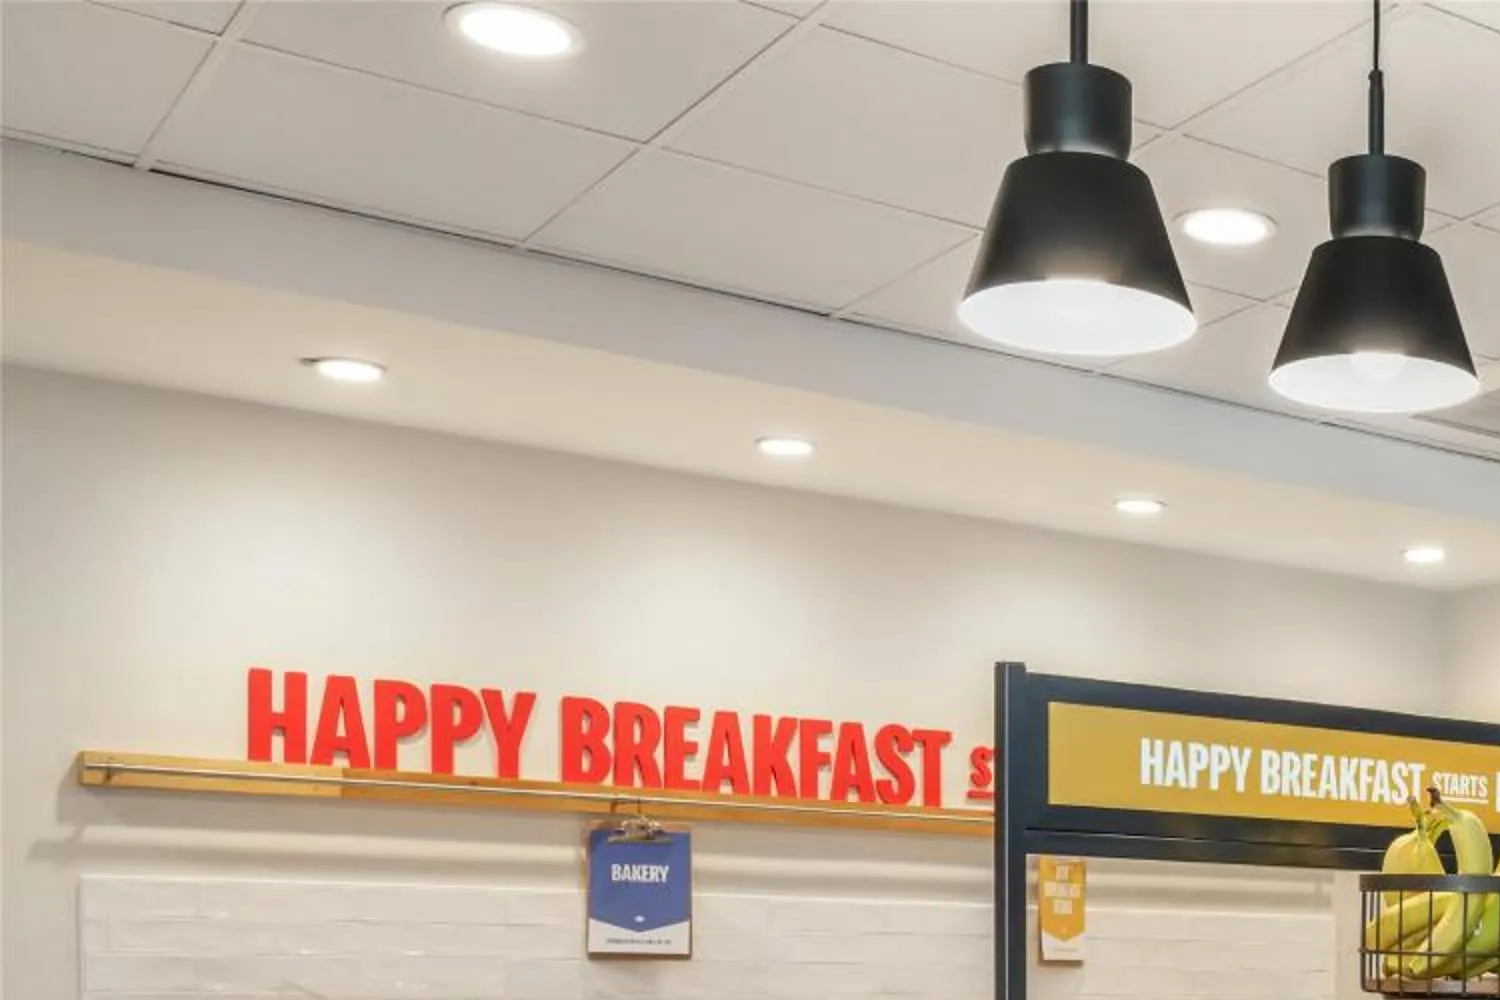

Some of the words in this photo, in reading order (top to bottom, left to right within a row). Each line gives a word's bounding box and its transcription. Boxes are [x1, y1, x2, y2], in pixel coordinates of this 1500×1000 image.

[248, 667, 536, 779] HAPPY
[561, 696, 952, 808] BREAKFAST
[1141, 737, 1252, 793] HAPPY
[1261, 749, 1425, 804] BREAKFAST
[1432, 771, 1488, 798] STARTS
[611, 863, 669, 883] BAKERY
